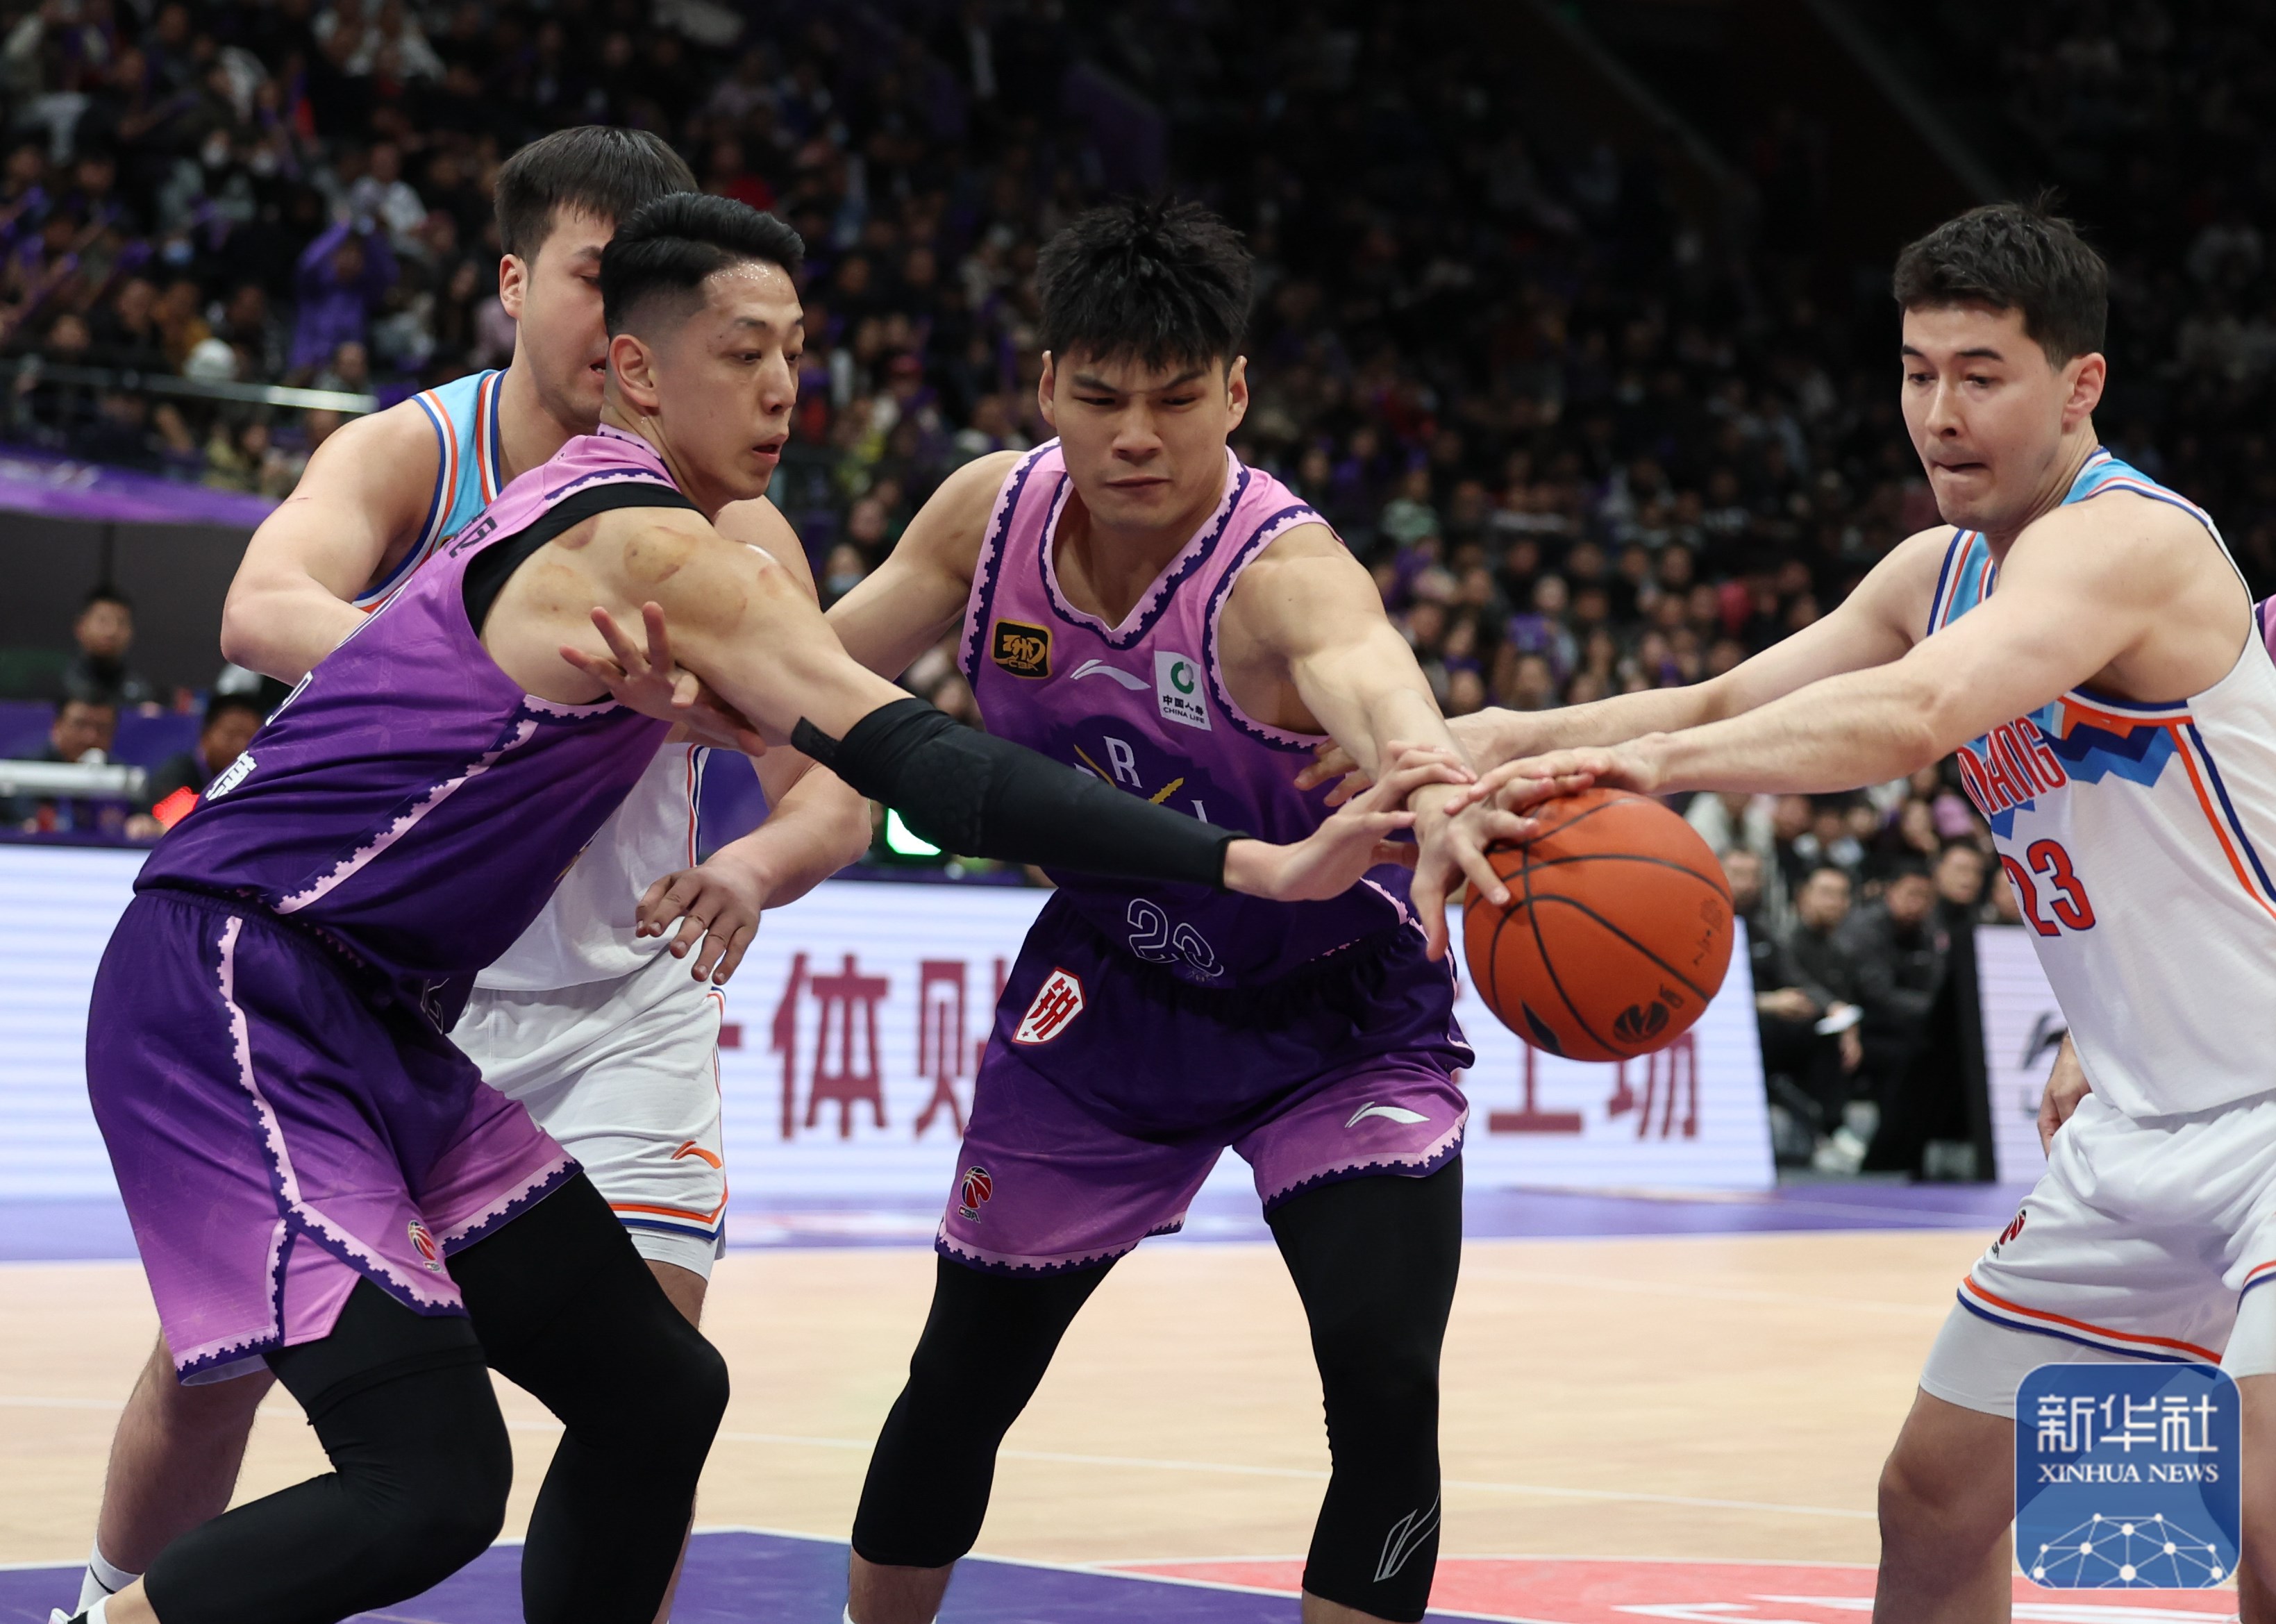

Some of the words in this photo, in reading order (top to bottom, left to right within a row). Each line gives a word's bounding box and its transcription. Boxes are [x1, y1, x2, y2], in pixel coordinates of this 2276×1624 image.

[1163, 707, 1188, 718] CHINA
[1189, 713, 1205, 724] LIFE
[2000, 839, 2096, 937] 23
[958, 1205, 980, 1223] CBA
